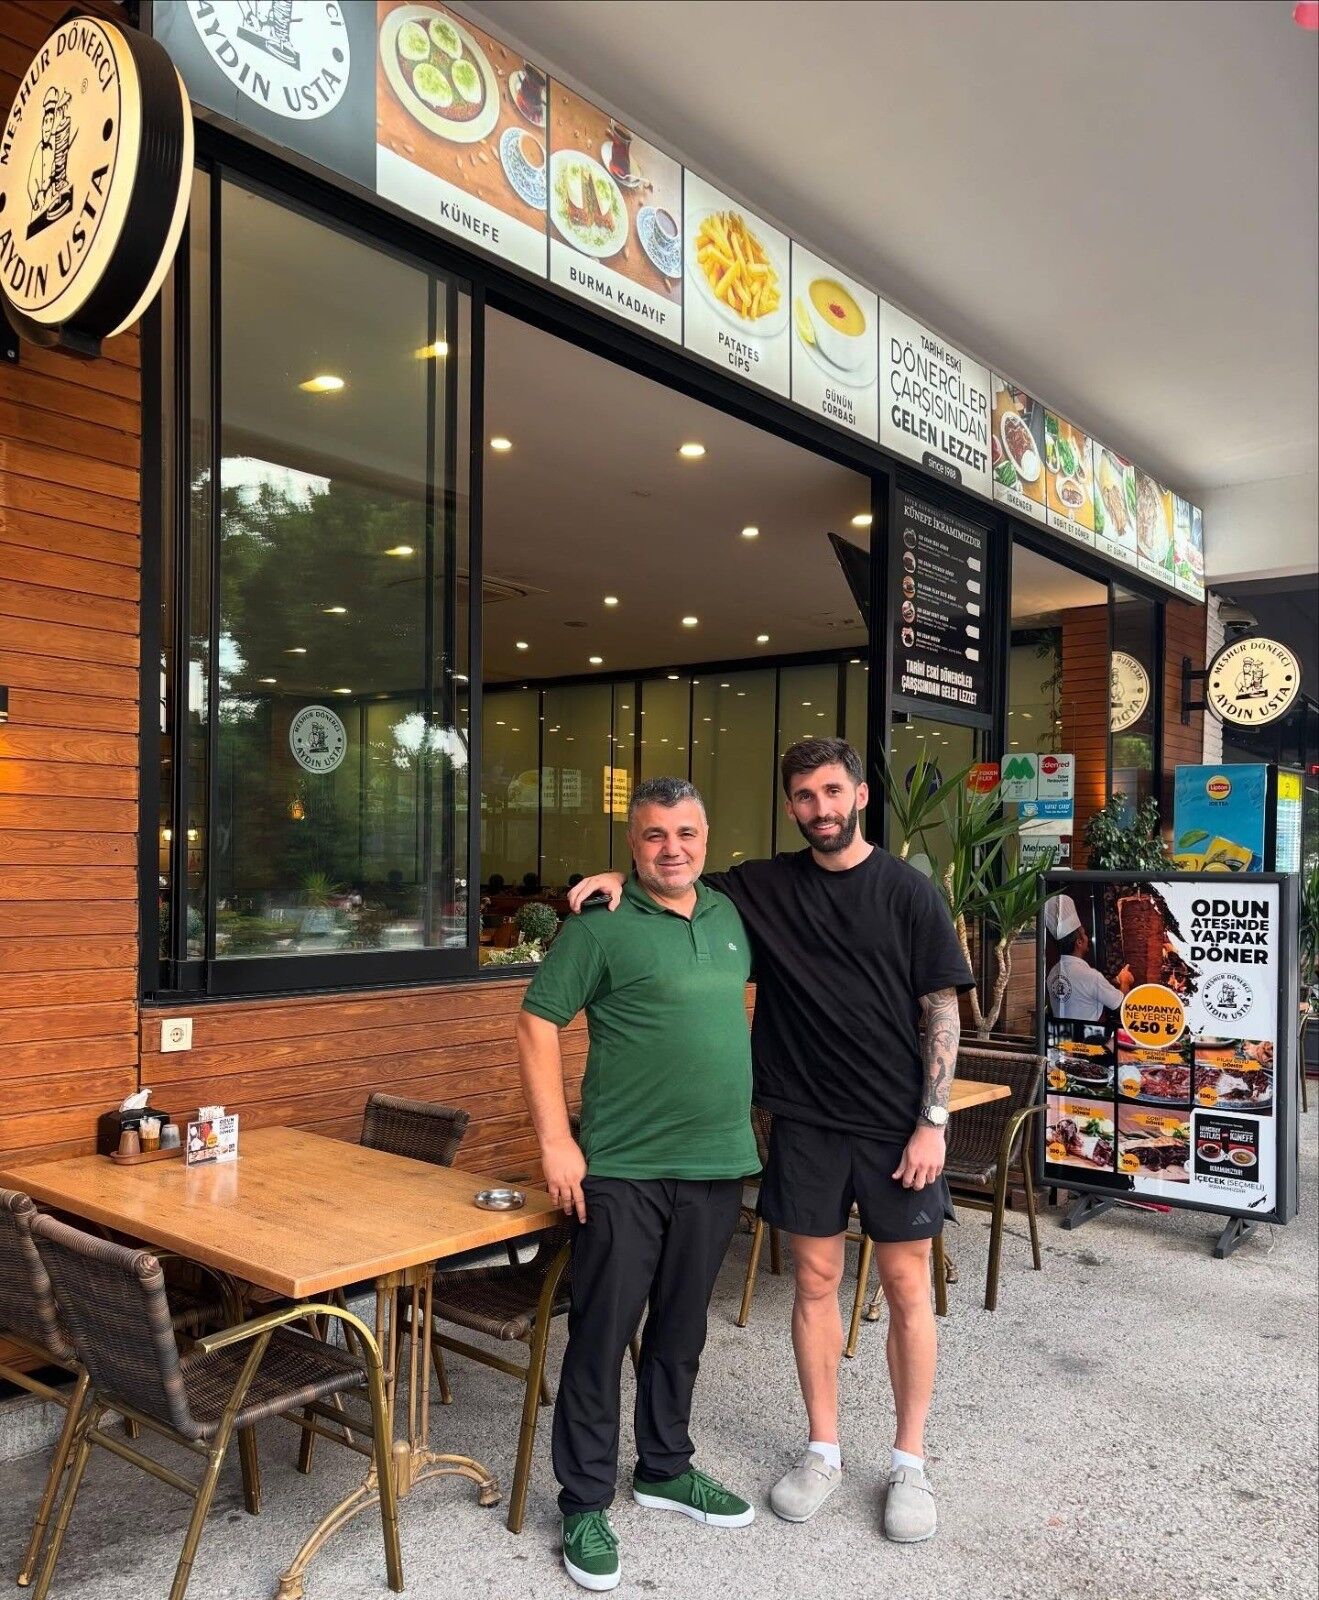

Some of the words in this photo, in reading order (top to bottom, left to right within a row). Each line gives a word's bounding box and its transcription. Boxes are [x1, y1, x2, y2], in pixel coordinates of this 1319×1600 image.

[196, 1, 271, 102] AYDIN
[283, 68, 342, 112] USTA
[0, 48, 50, 165] MEŞHUR
[56, 21, 116, 93] DÖNERCİ
[0, 229, 48, 298] AYDIN
[58, 164, 109, 278] USTA
[440, 201, 499, 243] KÜNEFE
[570, 267, 613, 299] BURMA
[617, 290, 666, 325] KADAYIF
[718, 332, 760, 363] PATATES
[728, 352, 751, 373] CİPS
[891, 337, 987, 419] DÖNERCİLER
[825, 388, 853, 411] GÜNÜN
[890, 370, 988, 446] ÇARŞISINDAN
[822, 400, 856, 425] ÇORBASI
[891, 404, 937, 447] GELEN
[941, 430, 988, 474] LEZZET
[904, 505, 933, 527] KÜNEFE
[1214, 693, 1253, 719] AYDIN
[1259, 687, 1291, 717] USTA
[296, 747, 321, 768] AYDIN
[324, 746, 342, 766] USTA
[1191, 899, 1269, 919] ODUN
[1190, 929, 1269, 945] YAPRAK
[1190, 942, 1269, 965] DÖNER
[1125, 1003, 1181, 1015] KAMPANYA
[1126, 1011, 1141, 1020] NE
[1142, 1011, 1180, 1023] YERSEN
[1204, 1001, 1228, 1020] AYDIN
[1231, 1003, 1250, 1020] USTA
[1128, 1022, 1160, 1034] 450
